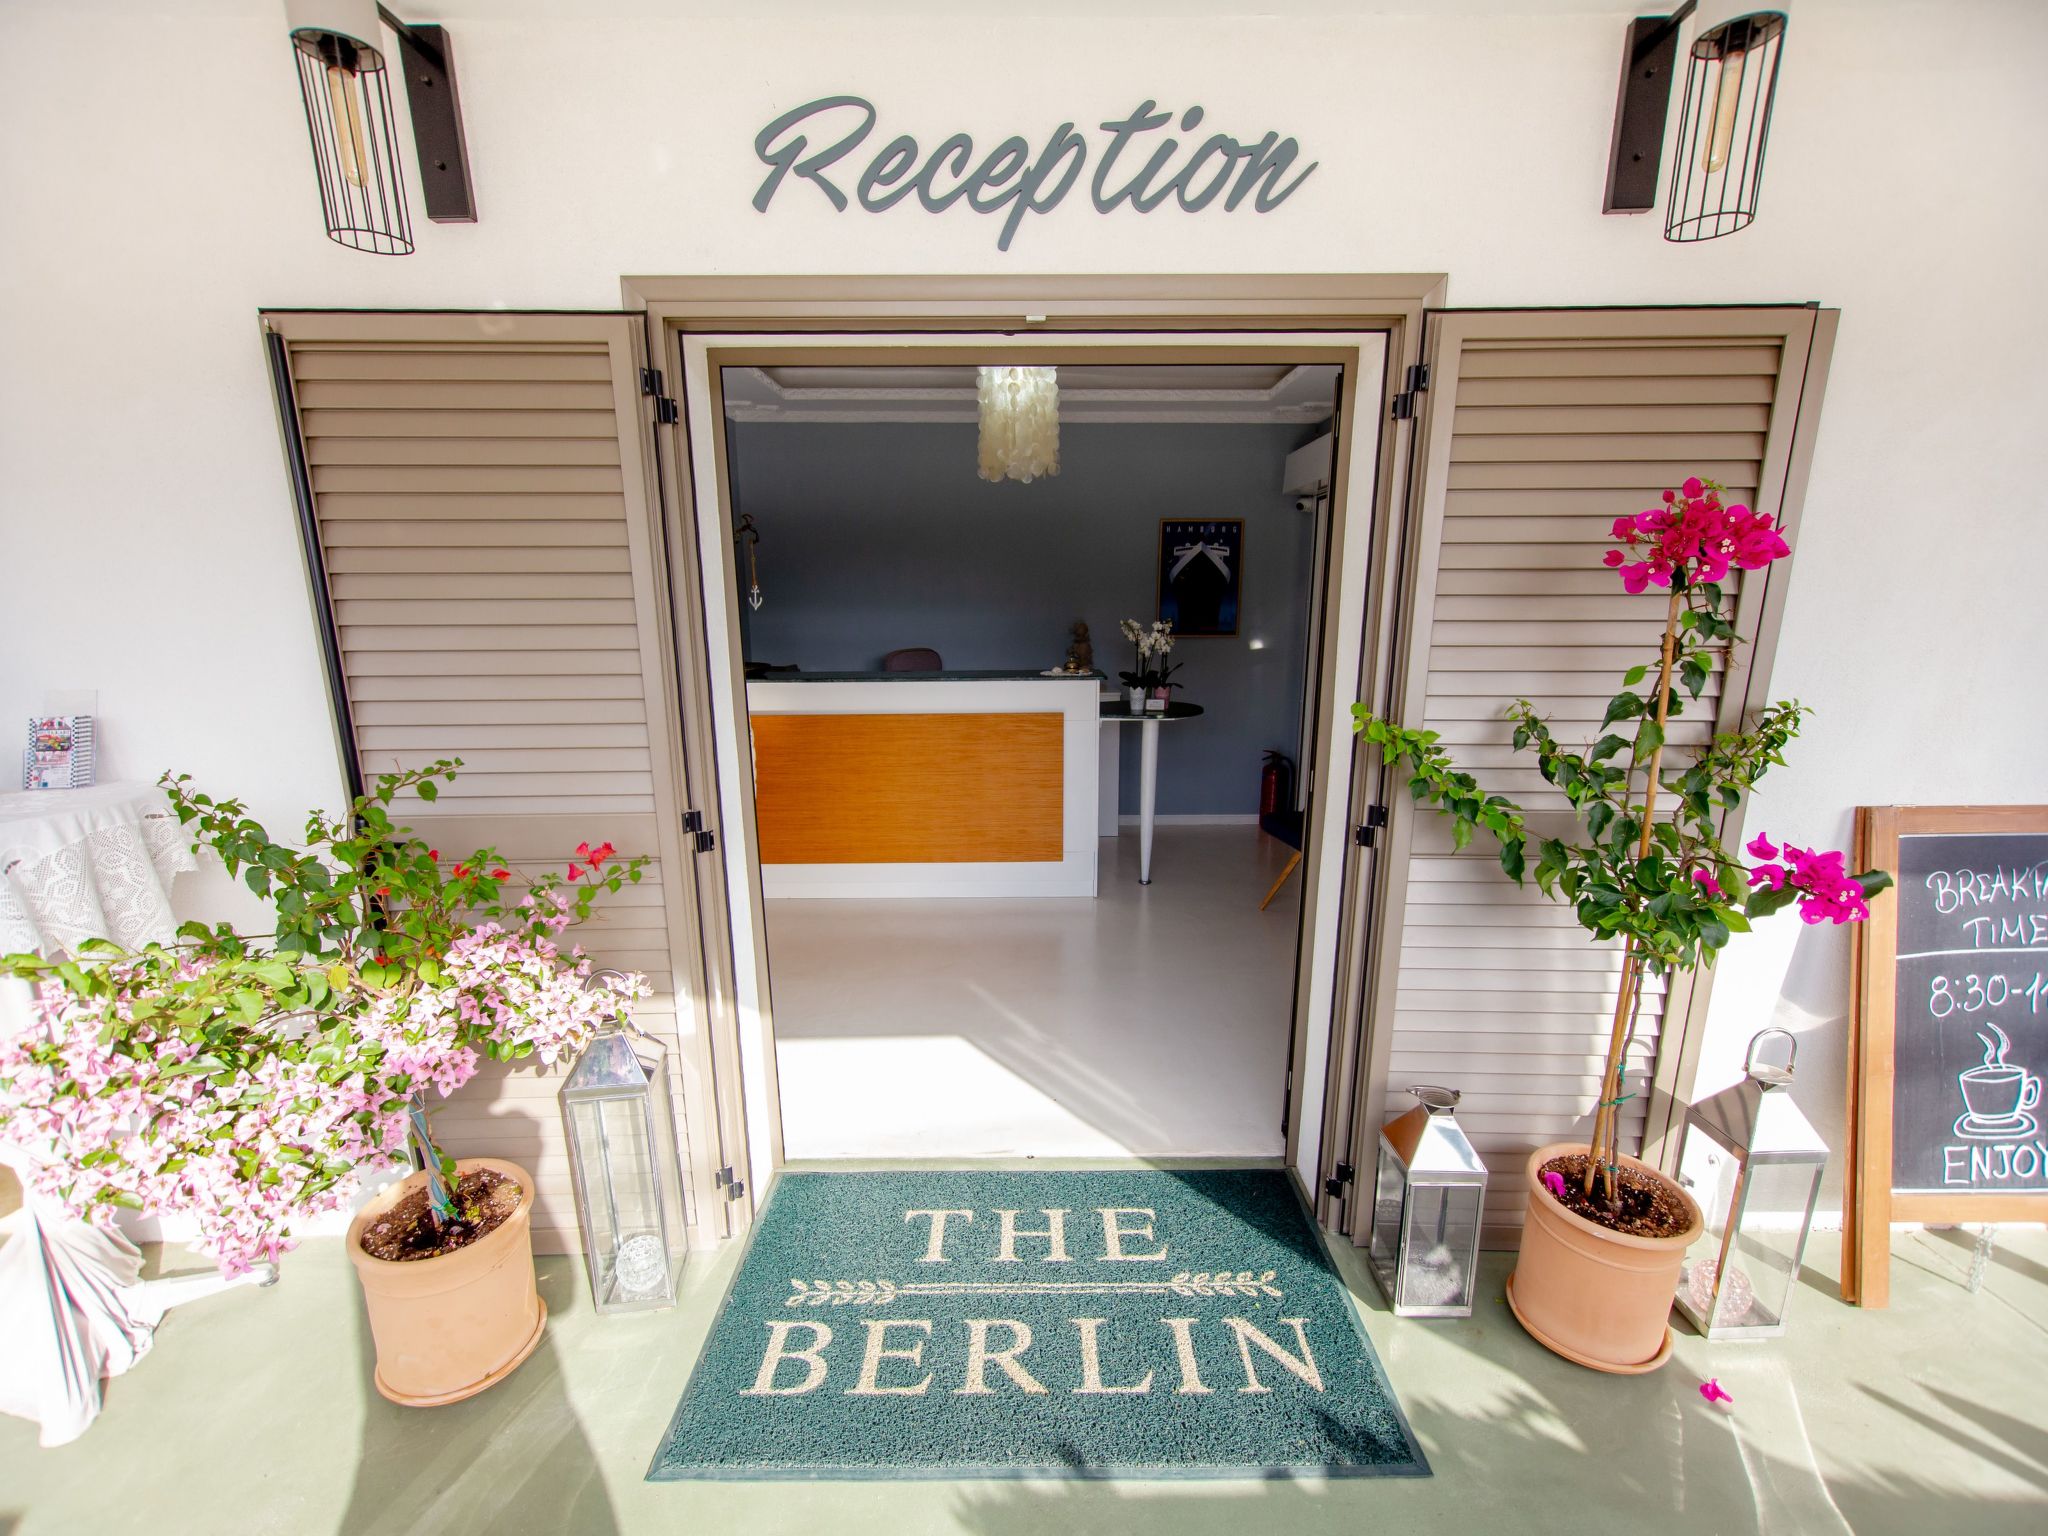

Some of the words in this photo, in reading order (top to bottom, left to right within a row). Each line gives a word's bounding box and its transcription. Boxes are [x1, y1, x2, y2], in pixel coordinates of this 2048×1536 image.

[752, 95, 1319, 252] Reception
[1166, 525, 1237, 534] HAMBURG
[904, 1207, 1169, 1263] THE
[739, 1316, 1326, 1397] BERLIN
